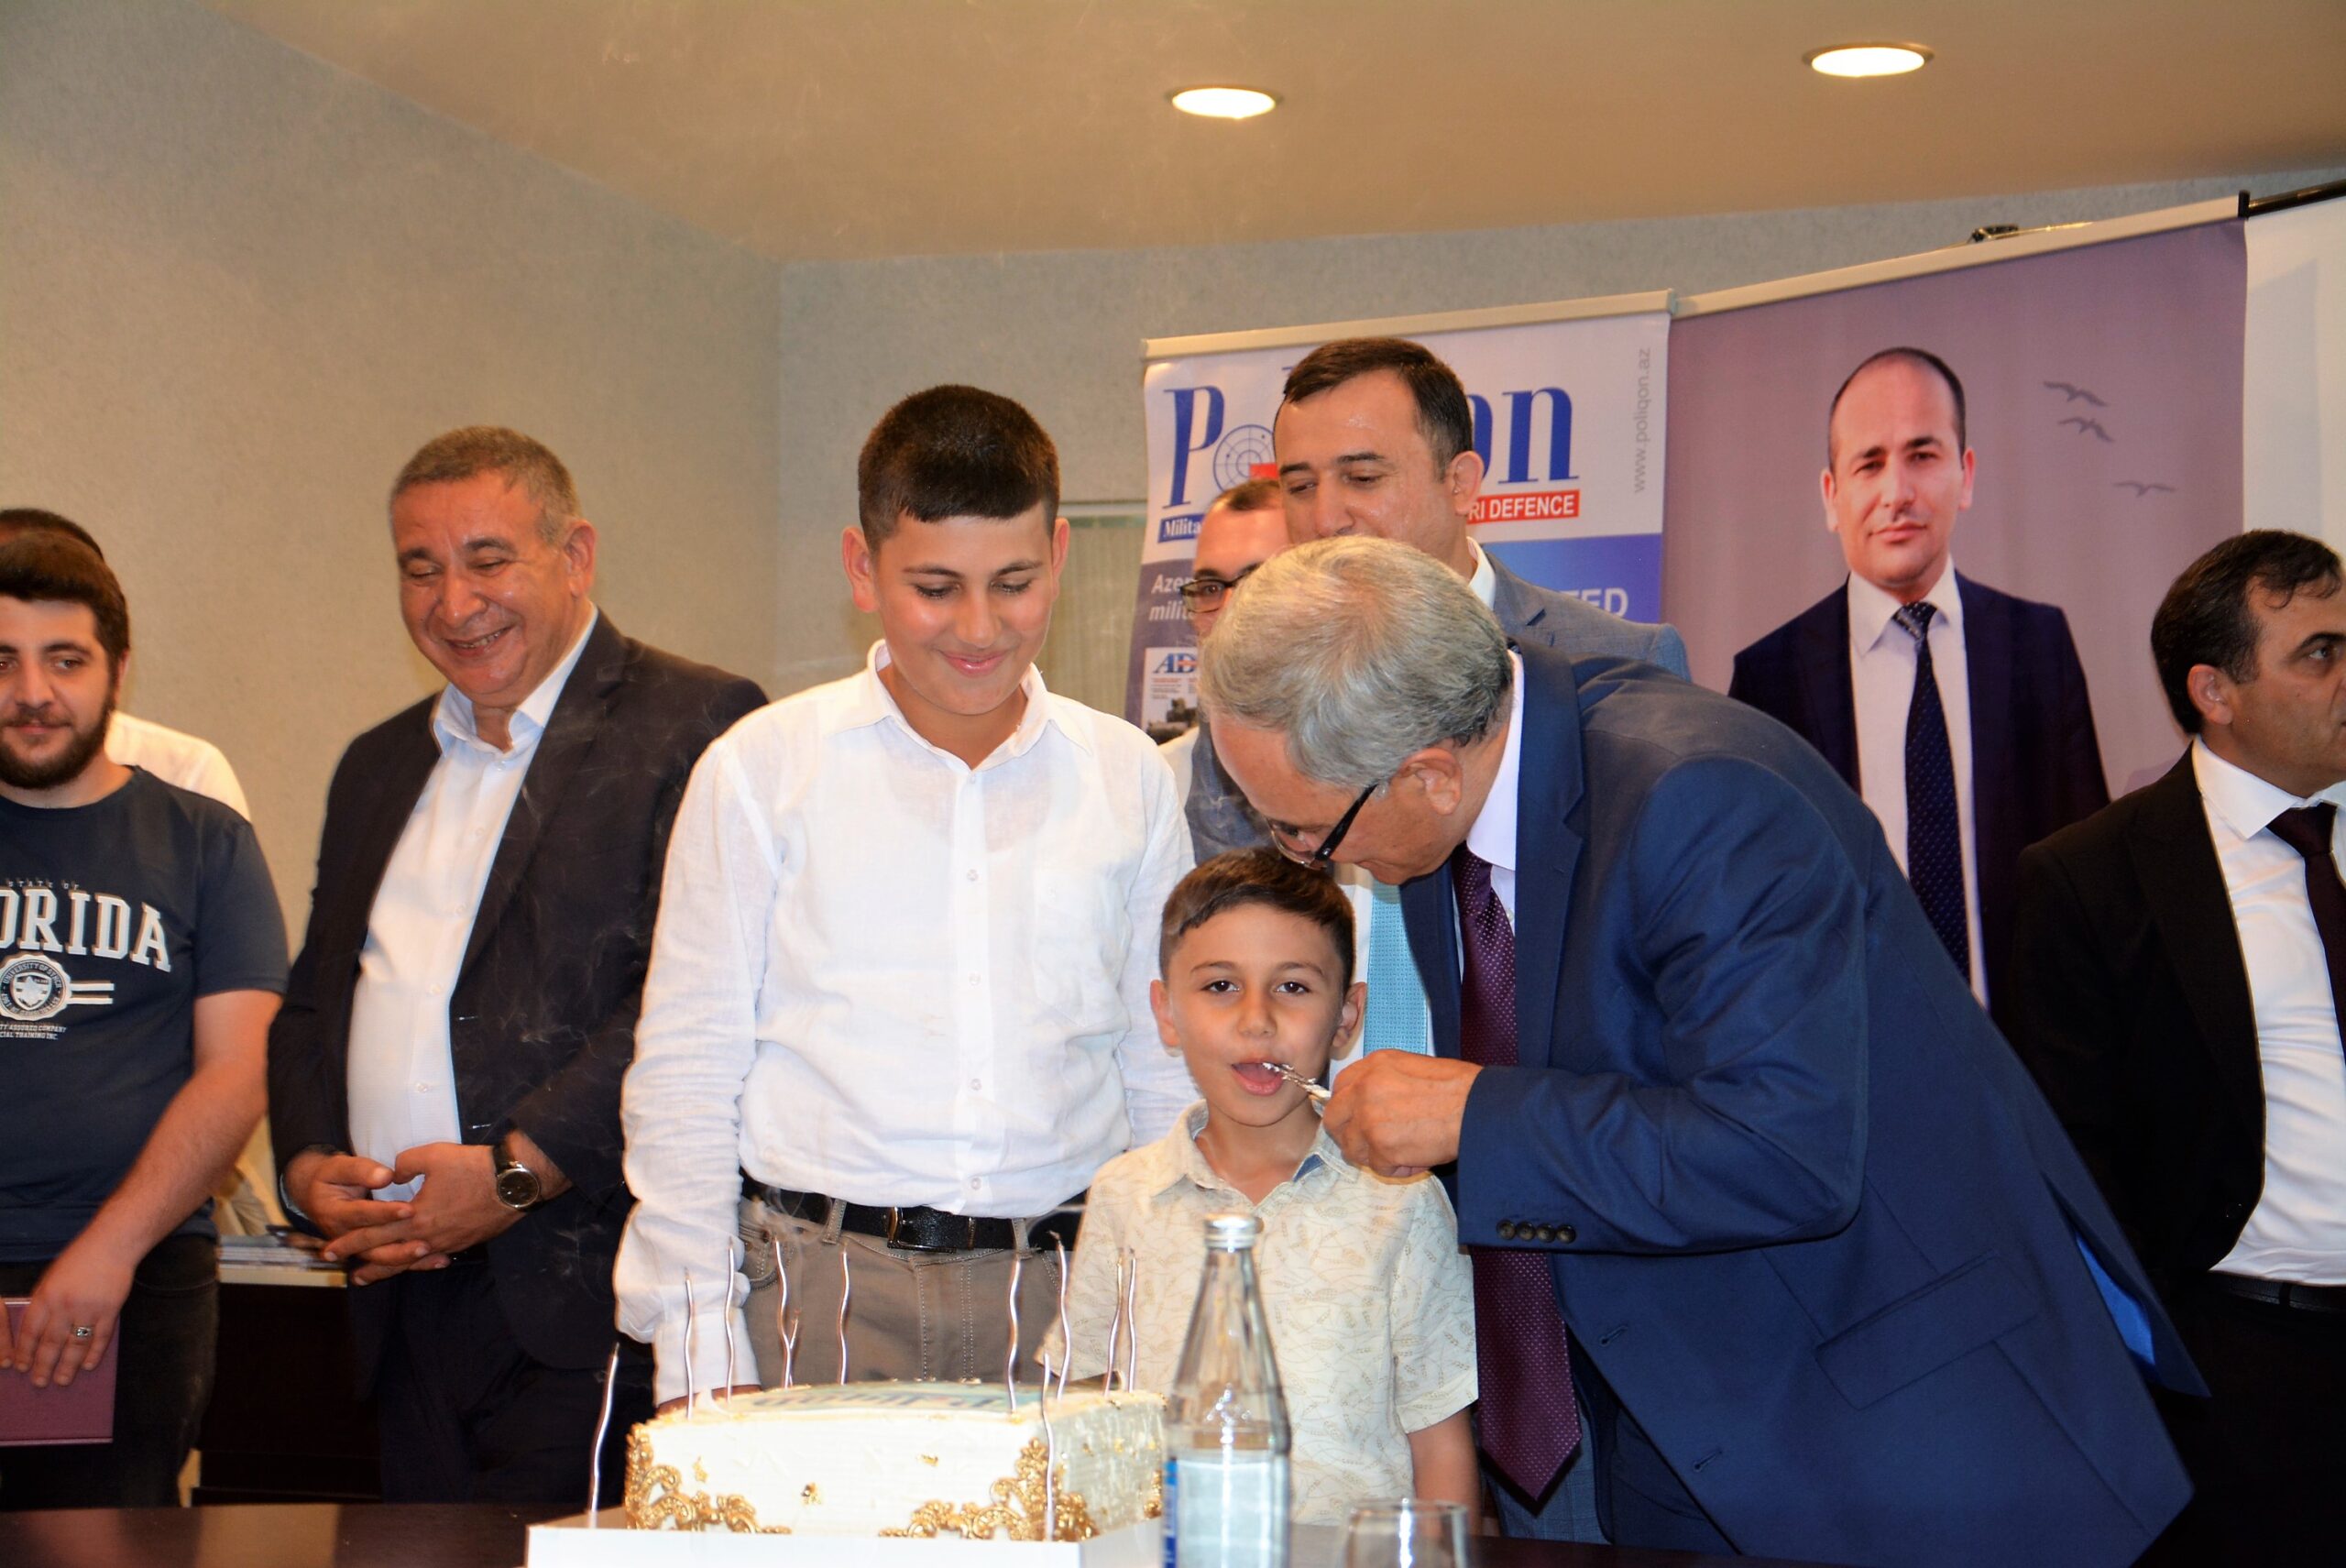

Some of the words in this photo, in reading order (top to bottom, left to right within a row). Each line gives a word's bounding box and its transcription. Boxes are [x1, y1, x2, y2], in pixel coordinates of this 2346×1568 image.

[1633, 347, 1651, 494] www.poliqon.az
[1489, 494, 1575, 520] DEFENCE
[1163, 518, 1201, 537] Milita
[8, 881, 53, 889] STATE
[63, 883, 79, 891] OF
[0, 885, 171, 973] ORIDA
